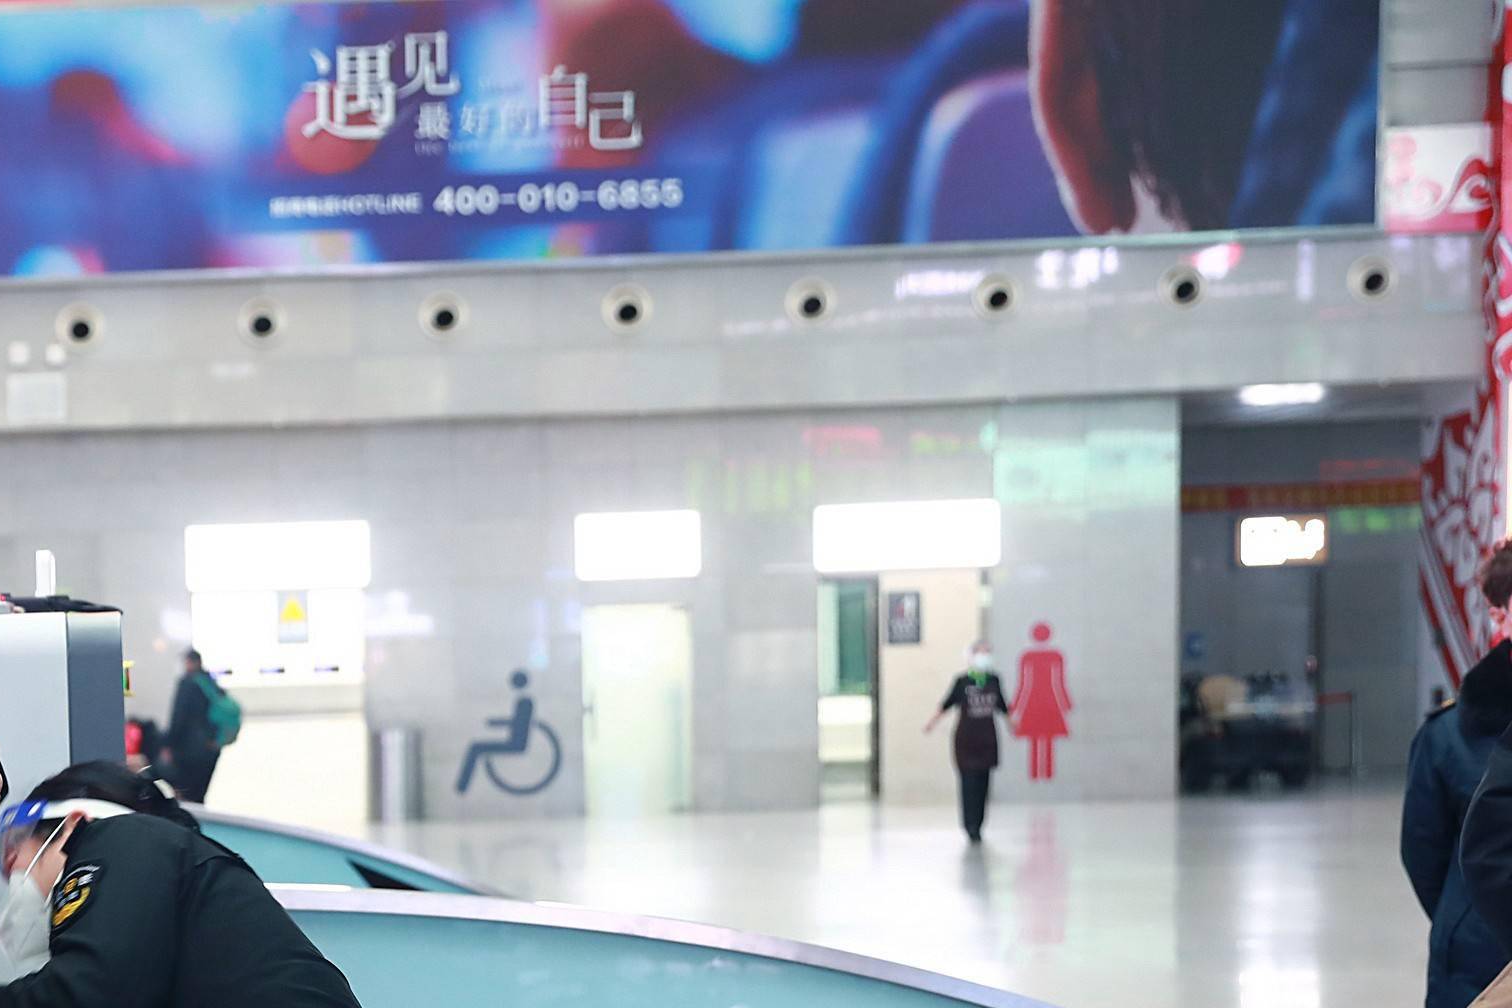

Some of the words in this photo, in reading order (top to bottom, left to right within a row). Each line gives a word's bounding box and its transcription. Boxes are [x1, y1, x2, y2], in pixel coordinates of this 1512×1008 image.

[301, 30, 461, 141] 遇见
[538, 64, 643, 150] 自己
[432, 178, 684, 216] 400-010-6855
